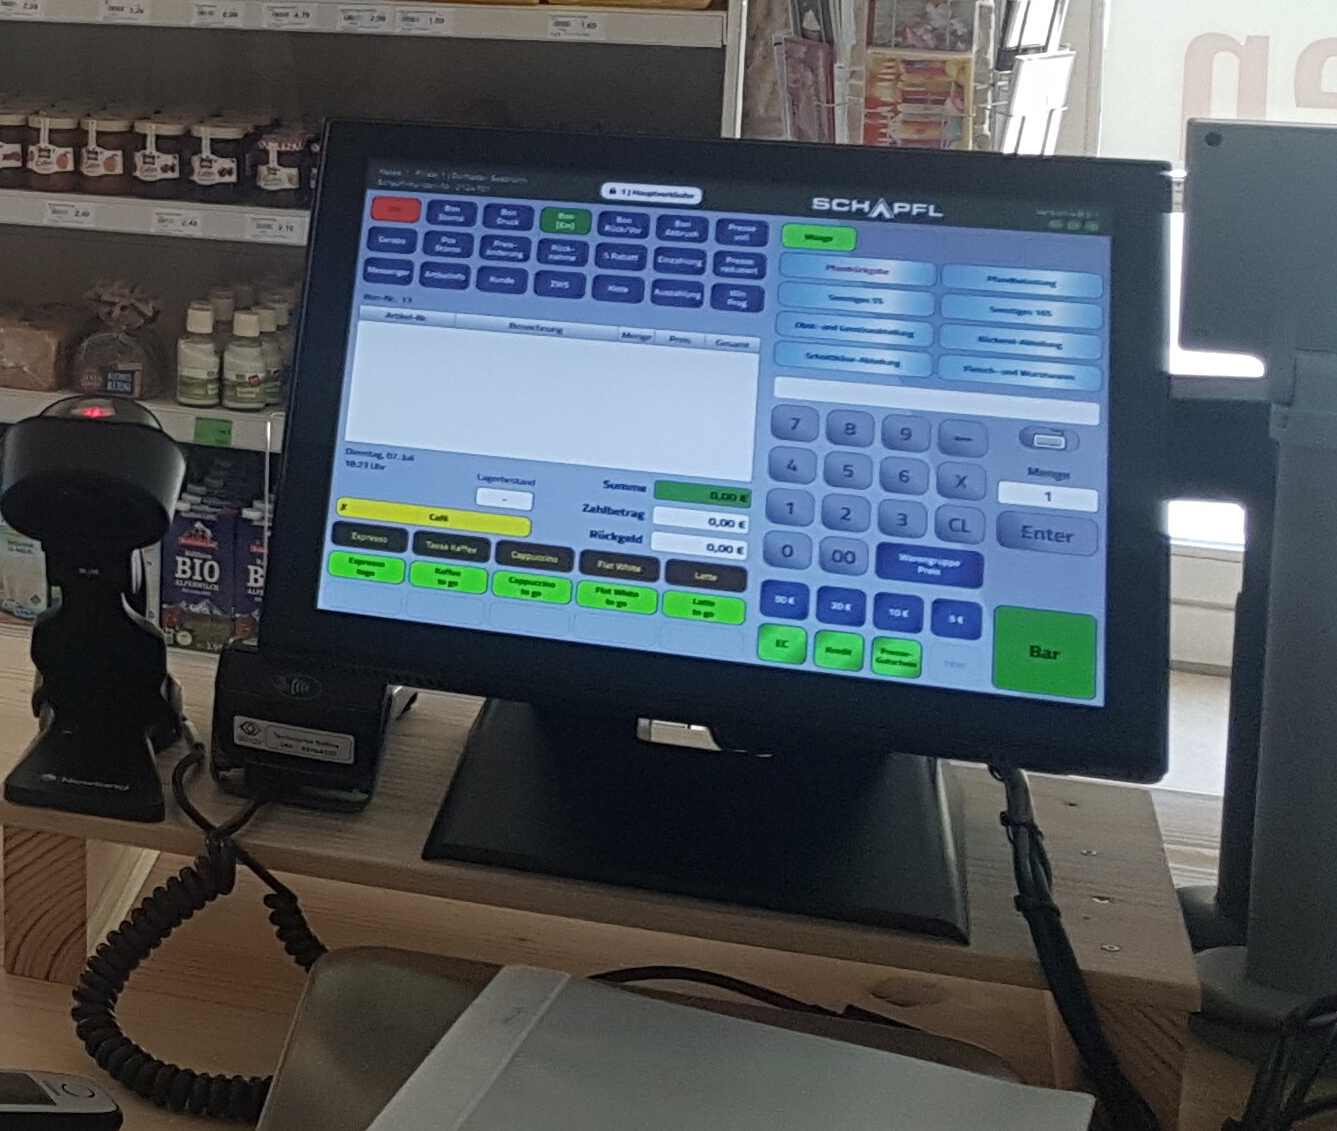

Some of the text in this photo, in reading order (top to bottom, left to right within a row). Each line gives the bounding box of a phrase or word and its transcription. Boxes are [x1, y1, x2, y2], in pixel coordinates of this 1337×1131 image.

[790, 417, 912, 441] 7 8 9
[786, 459, 967, 489] 4 5 6 X
[603, 479, 647, 493] Summe
[710, 490, 737, 503] 0,00
[1044, 489, 1052, 502] 1
[582, 503, 747, 529] Zahlbetrag 0,00 €
[786, 502, 971, 534] 1 2 3 CL
[351, 531, 388, 544] Espresso
[589, 529, 745, 555] Rückgeld 0,00 €
[1020, 524, 1075, 545] Enter
[781, 543, 857, 566] 0 00
[898, 552, 961, 569] Warengruppe
[174, 556, 220, 583] BIO
[775, 638, 790, 650] EC
[1029, 644, 1062, 662] Bar
